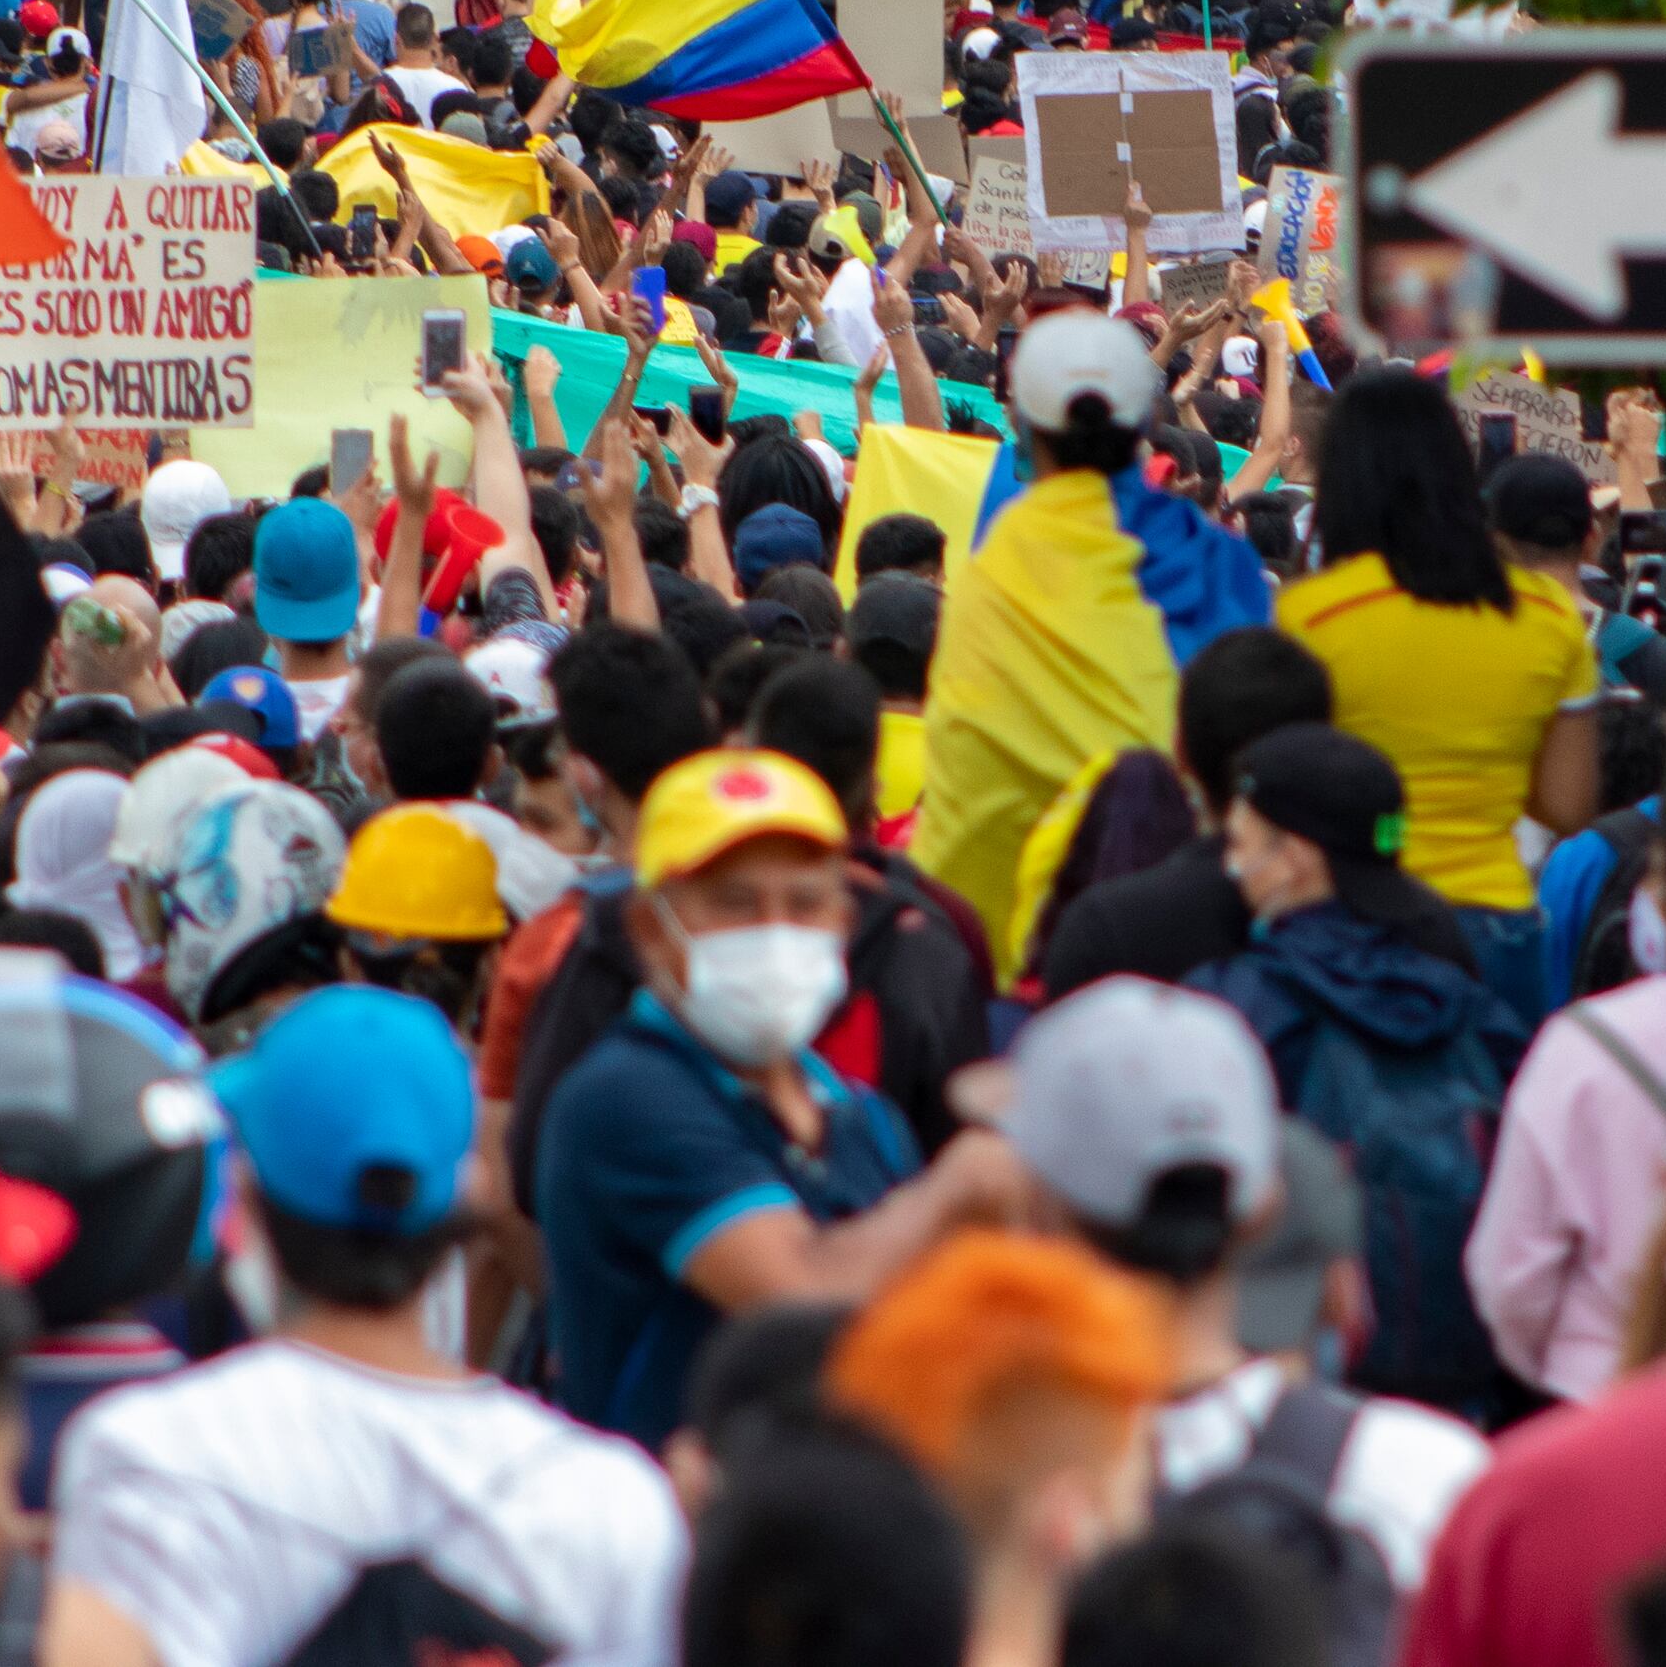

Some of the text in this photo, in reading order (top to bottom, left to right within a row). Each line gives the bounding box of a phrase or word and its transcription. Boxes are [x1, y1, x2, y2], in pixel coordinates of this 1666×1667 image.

[104, 184, 129, 231] A
[146, 184, 253, 233] QUITAR
[161, 238, 207, 281] ES
